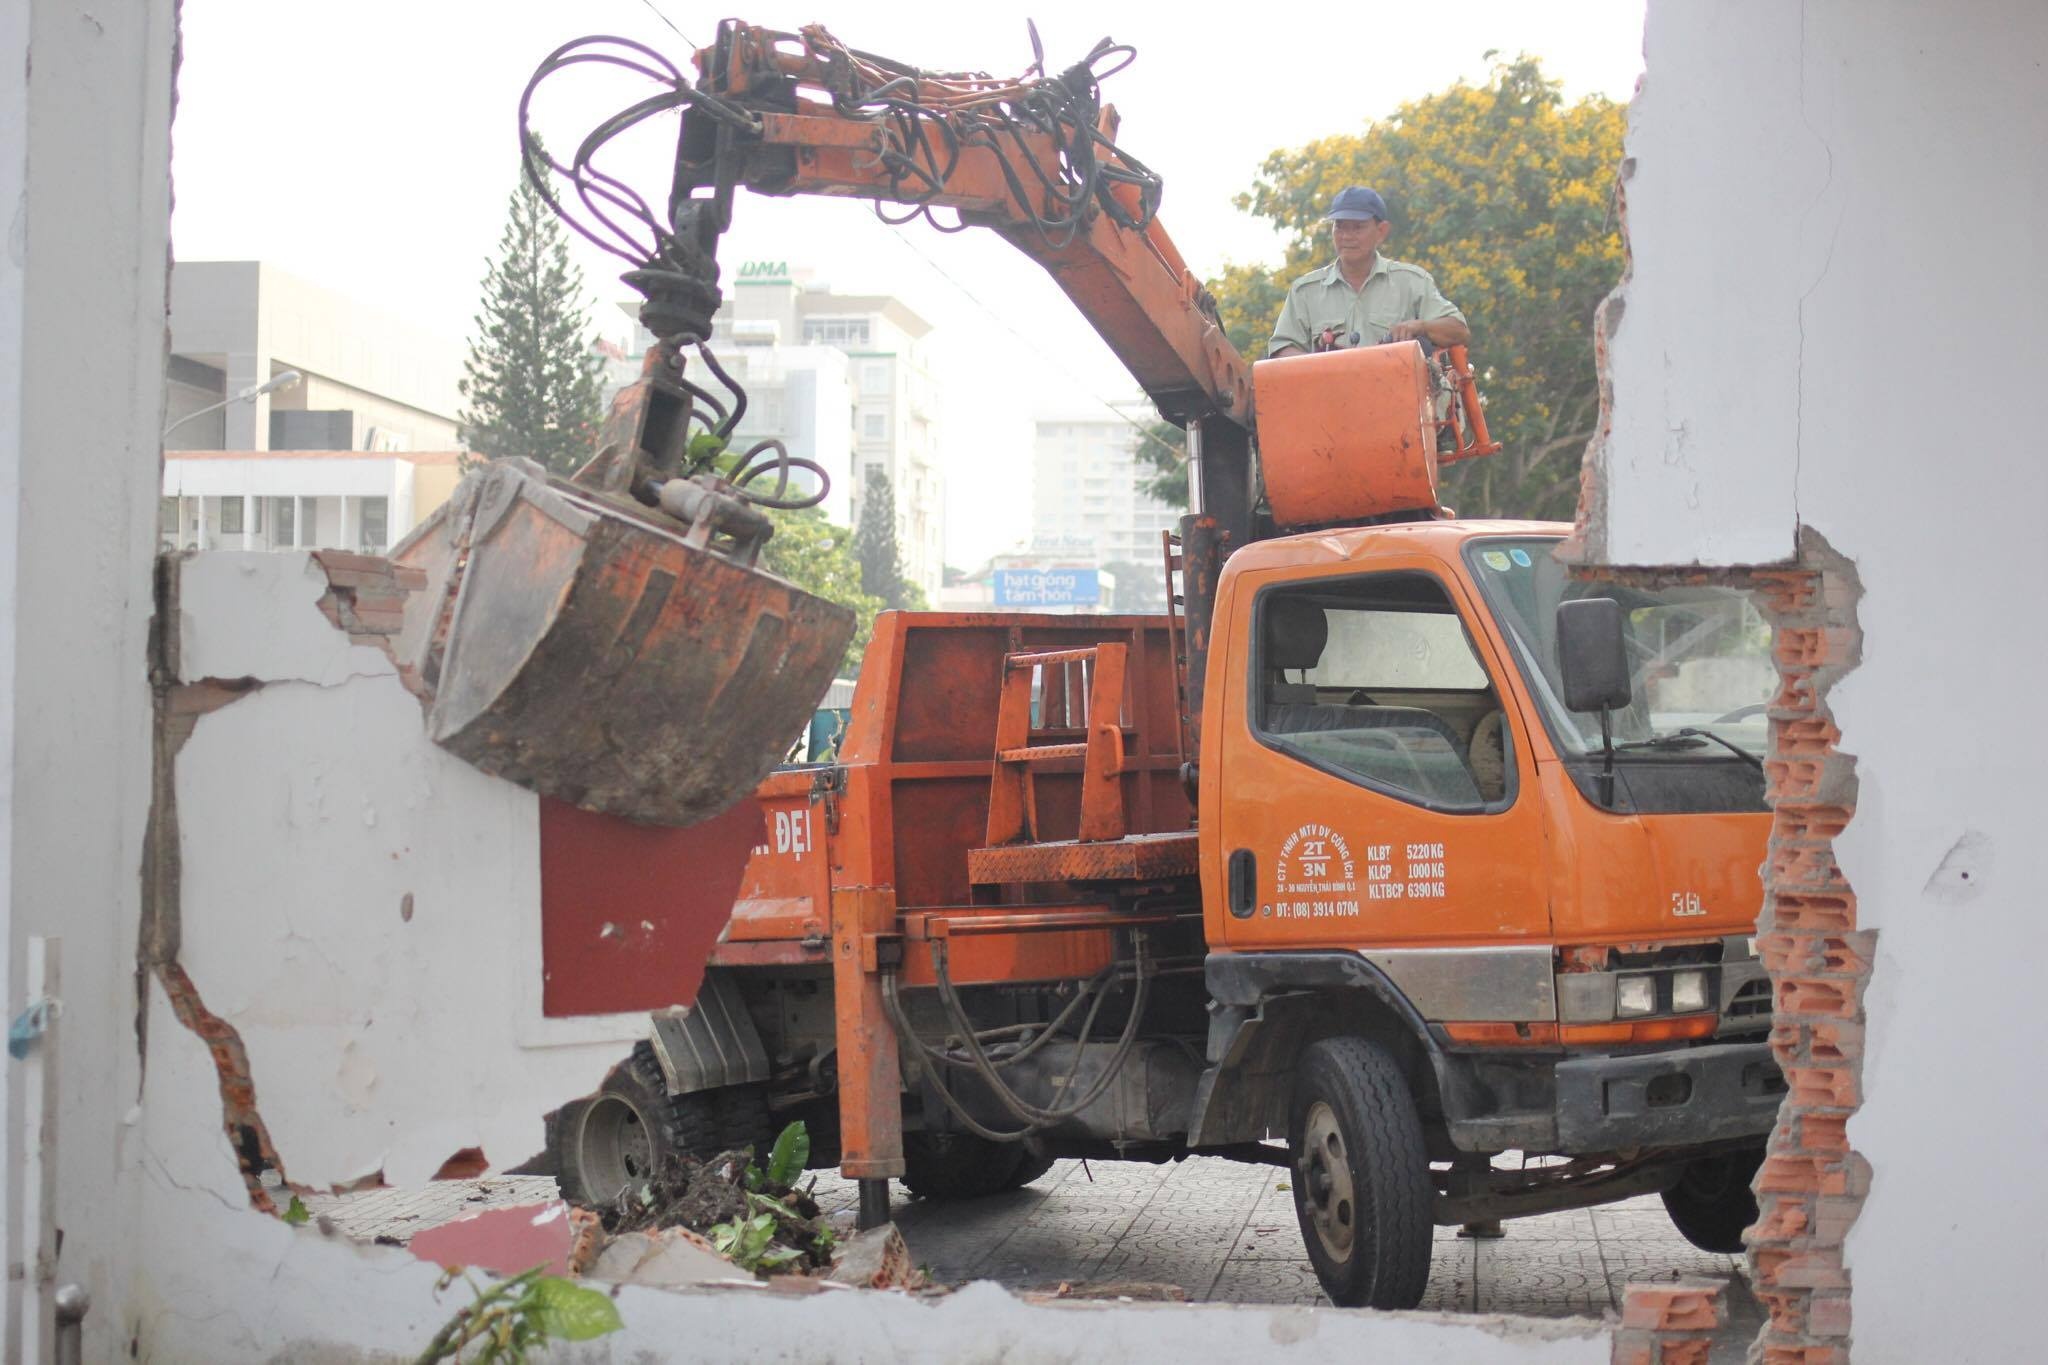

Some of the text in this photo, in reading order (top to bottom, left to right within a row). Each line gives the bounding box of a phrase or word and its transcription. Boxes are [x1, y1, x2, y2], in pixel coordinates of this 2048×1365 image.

[1299, 823, 1318, 838] MTV
[1318, 824, 1332, 839] DV
[1280, 832, 1300, 859] TNHH
[1303, 840, 1326, 856] 2T
[1367, 842, 1444, 862] KLBT 5220 KG
[1277, 859, 1287, 881] CTY
[1303, 861, 1327, 877] 3N
[1368, 861, 1445, 881] KLCP 1000 KG
[1368, 880, 1446, 900] KLTBCP 6390 KG
[1292, 900, 1311, 919] (08)
[1312, 900, 1335, 917] 3914
[1336, 899, 1359, 917] 0704
